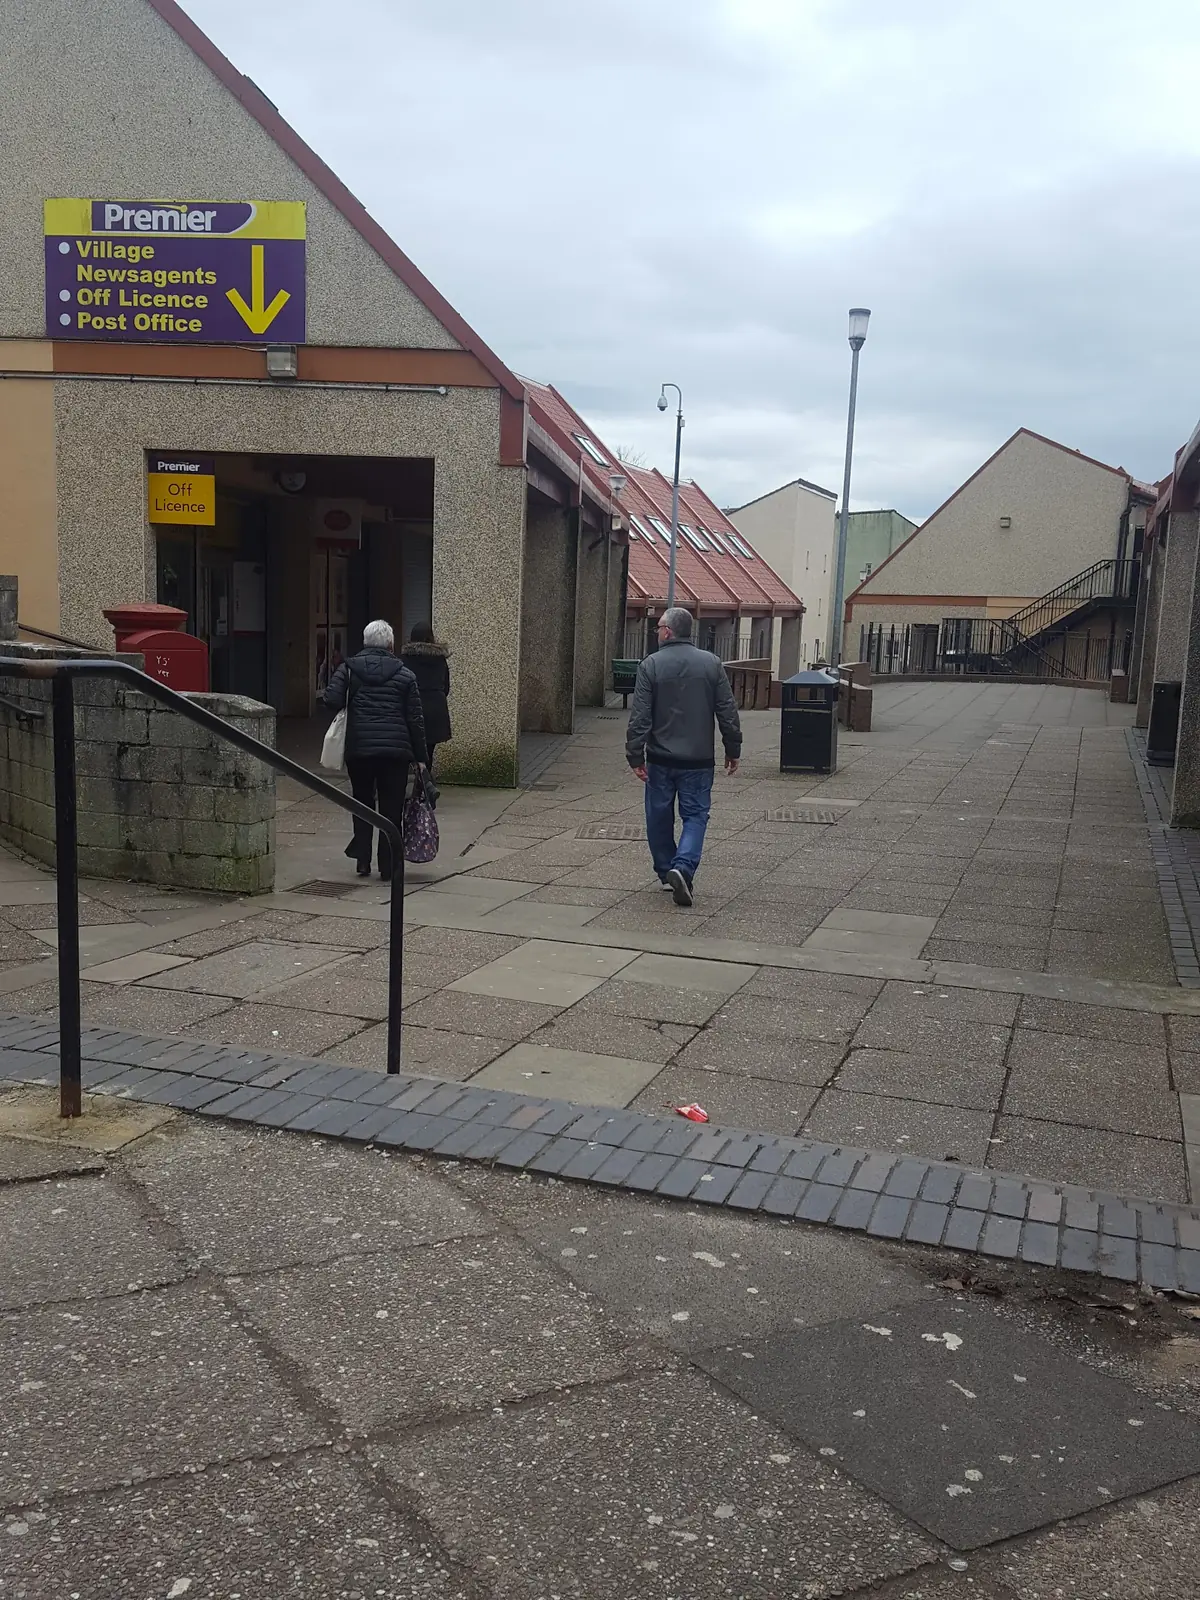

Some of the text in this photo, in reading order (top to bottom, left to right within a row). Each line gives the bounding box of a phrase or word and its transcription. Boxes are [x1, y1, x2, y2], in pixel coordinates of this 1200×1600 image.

[104, 203, 217, 232] Premier
[76, 240, 155, 263] Village
[76, 264, 217, 288] Newsagents
[76, 288, 208, 309] Off Licence
[77, 311, 202, 333] Post Office
[157, 461, 200, 472] Premier
[168, 483, 192, 497] Off
[155, 498, 206, 513] Licence
